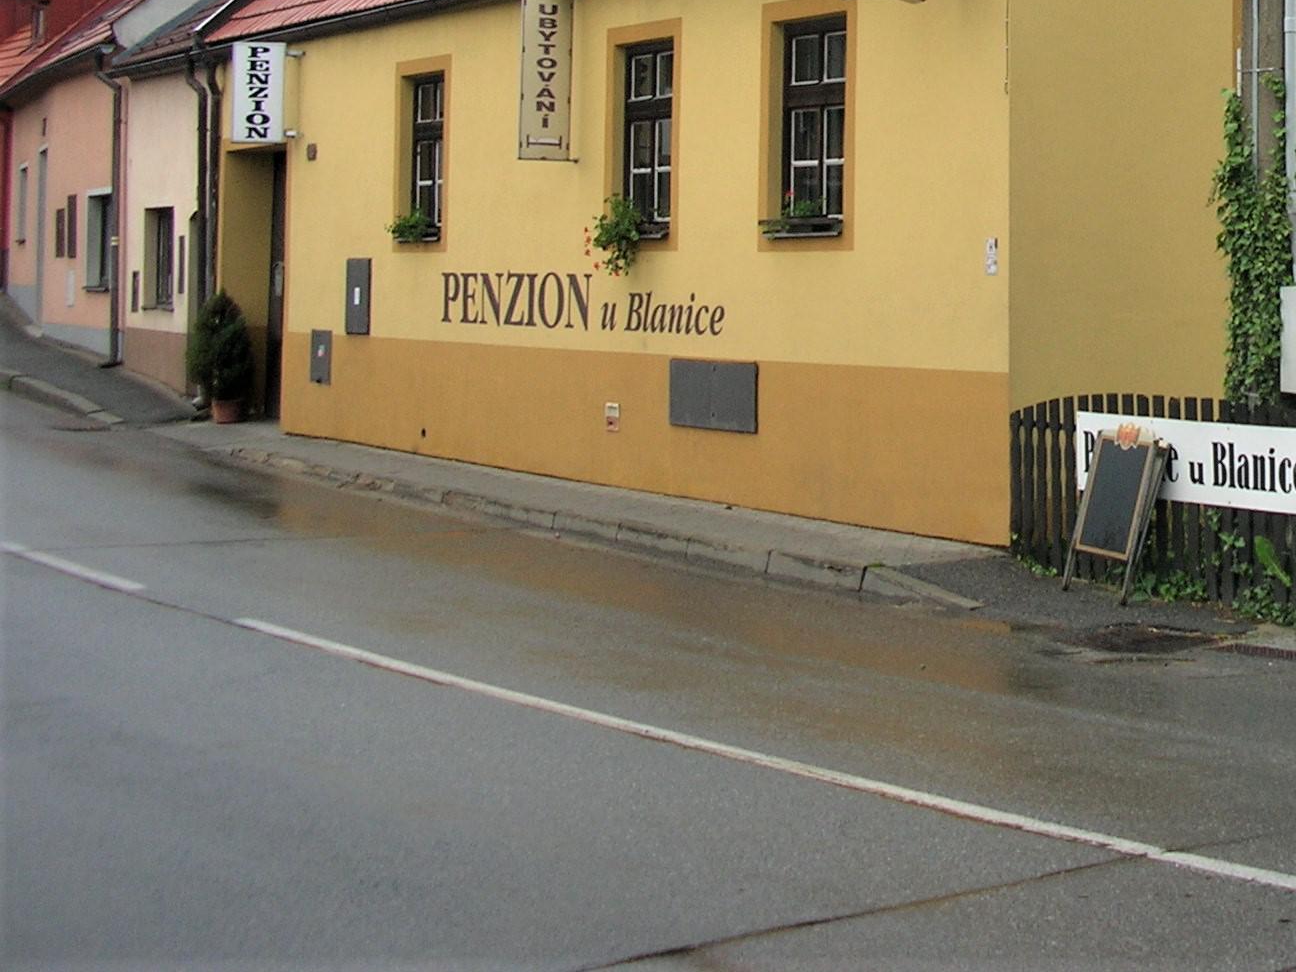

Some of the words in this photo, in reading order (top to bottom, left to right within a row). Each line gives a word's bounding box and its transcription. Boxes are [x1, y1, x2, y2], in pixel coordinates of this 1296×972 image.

[246, 46, 270, 139] PENZION
[441, 271, 593, 331] PENZION
[601, 300, 617, 331] u
[624, 291, 725, 336] Blanice
[1189, 460, 1205, 485] u
